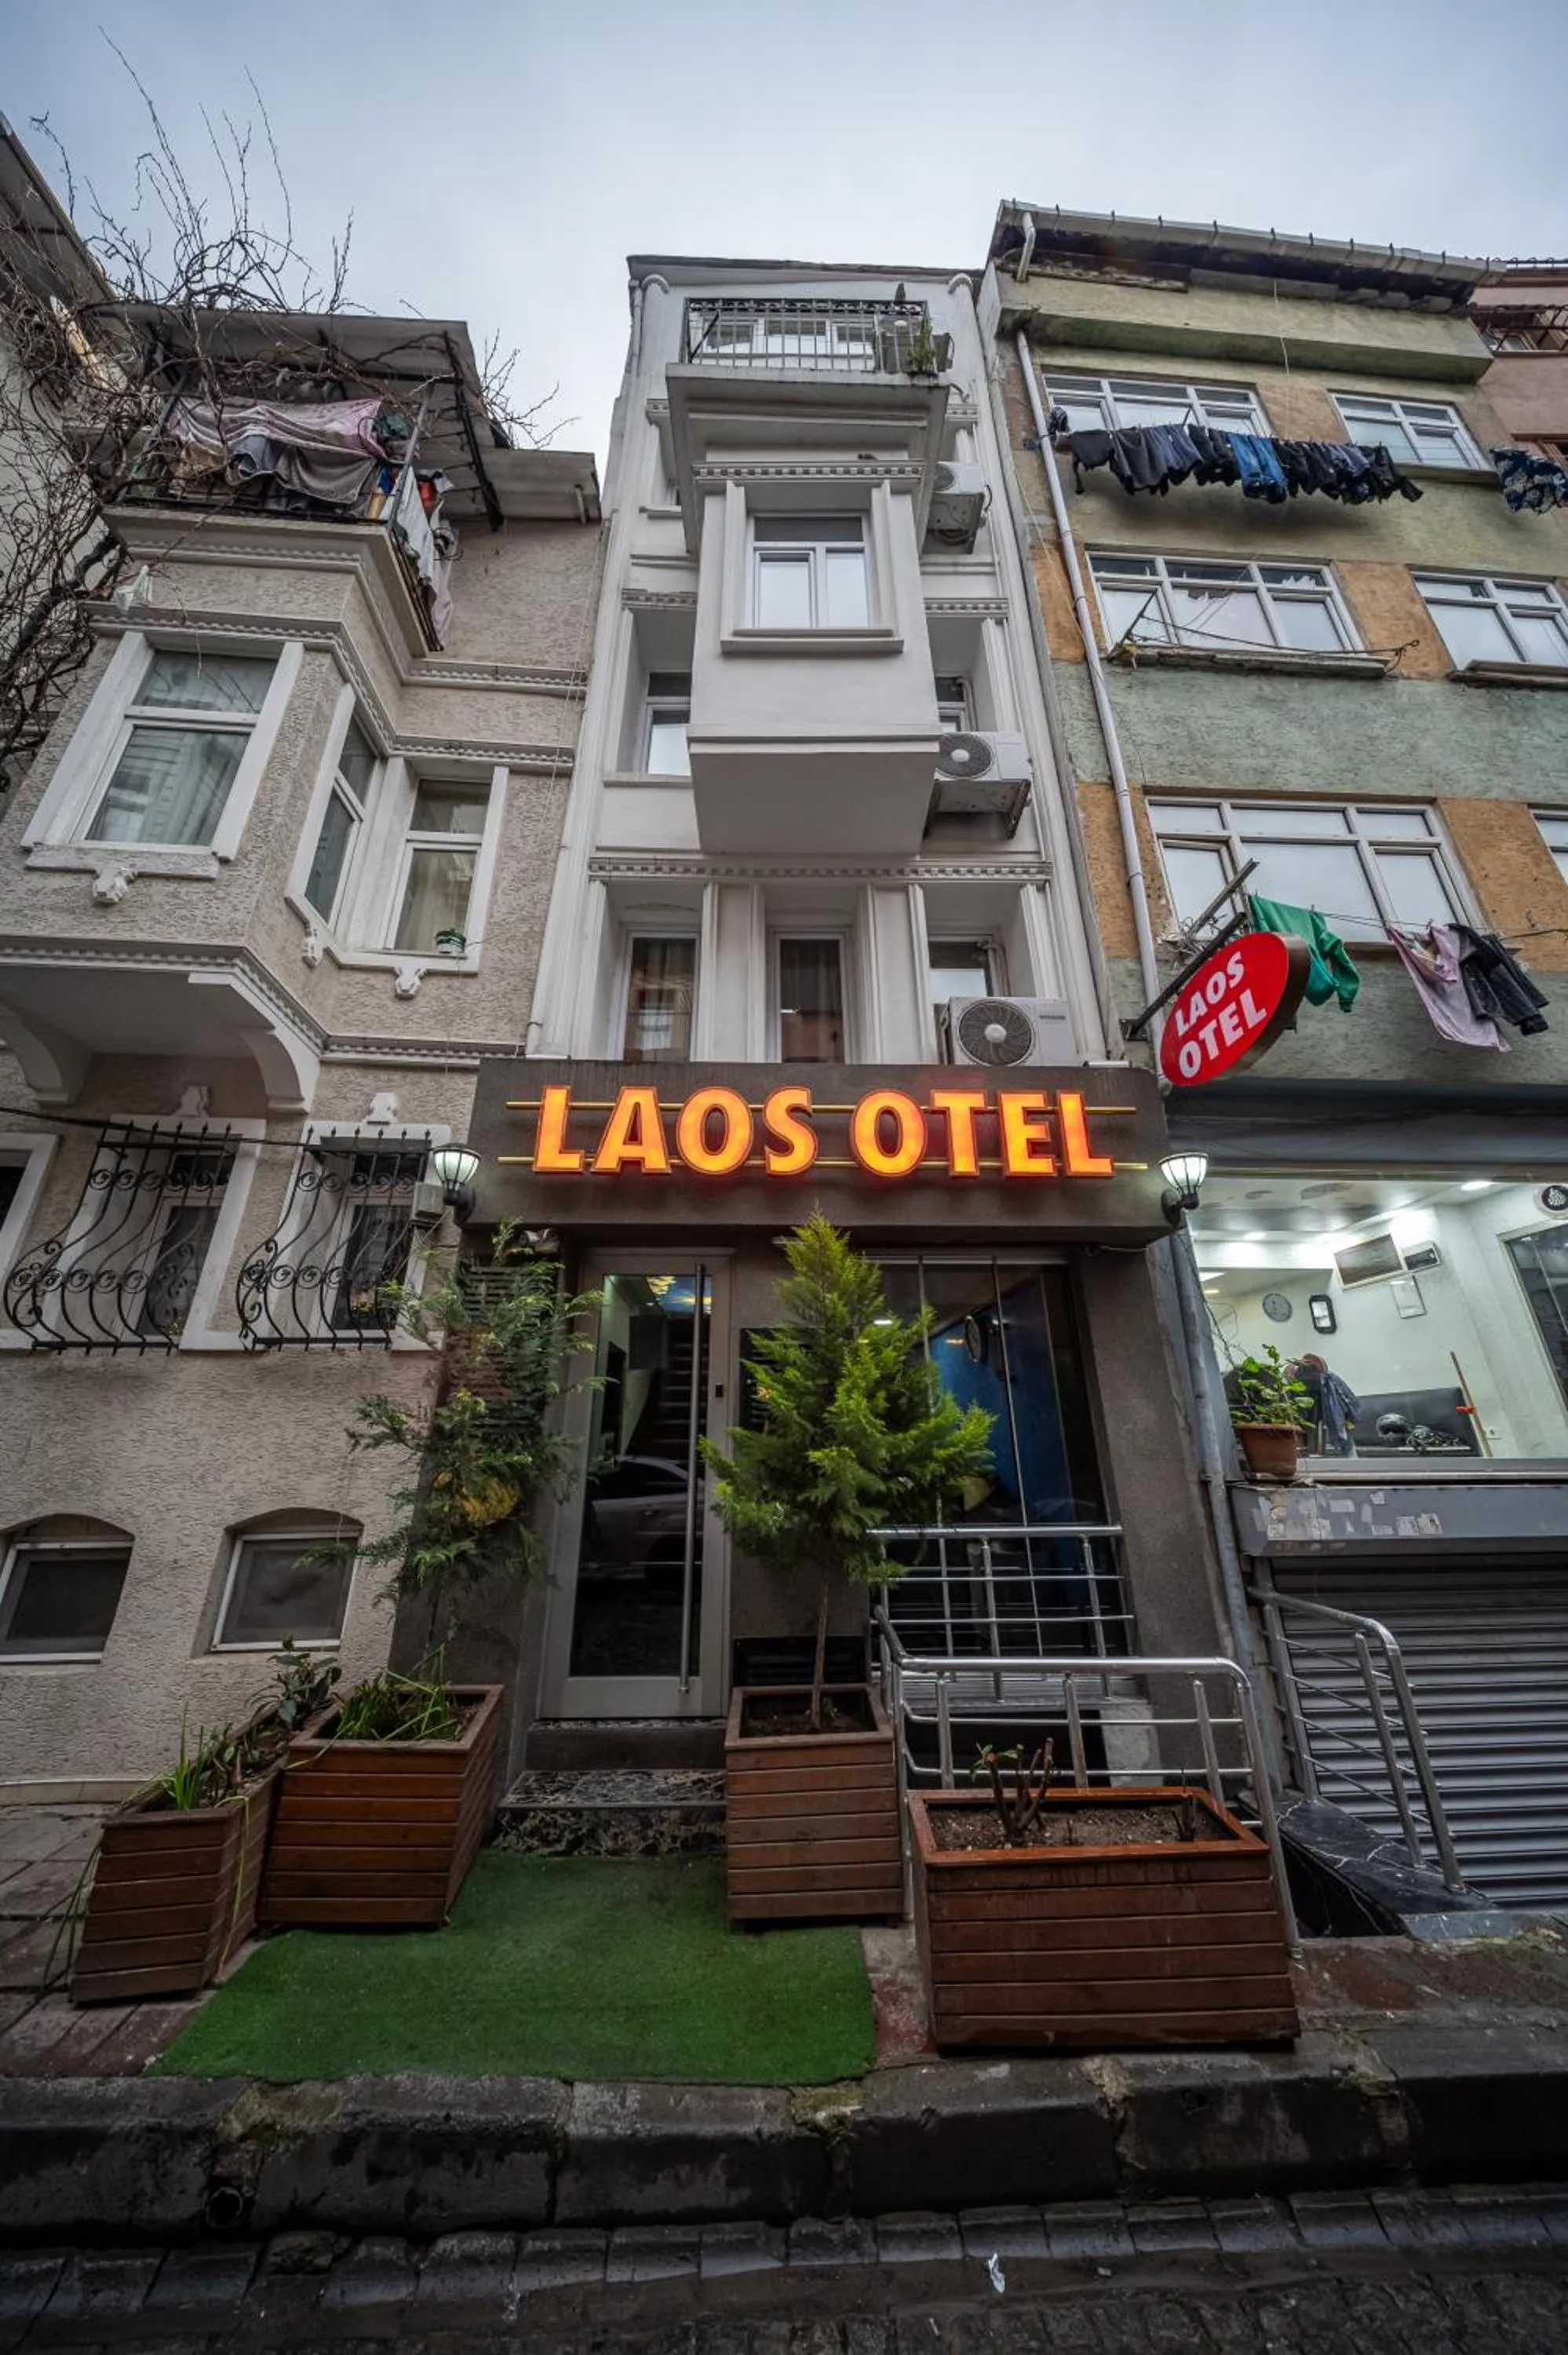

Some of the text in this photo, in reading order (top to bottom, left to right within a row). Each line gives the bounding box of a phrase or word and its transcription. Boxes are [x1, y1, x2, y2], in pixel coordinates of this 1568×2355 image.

[1174, 951, 1245, 1038] LAOS
[1179, 988, 1267, 1079] OTEL
[532, 1085, 1116, 1177] LAOS OTEL
